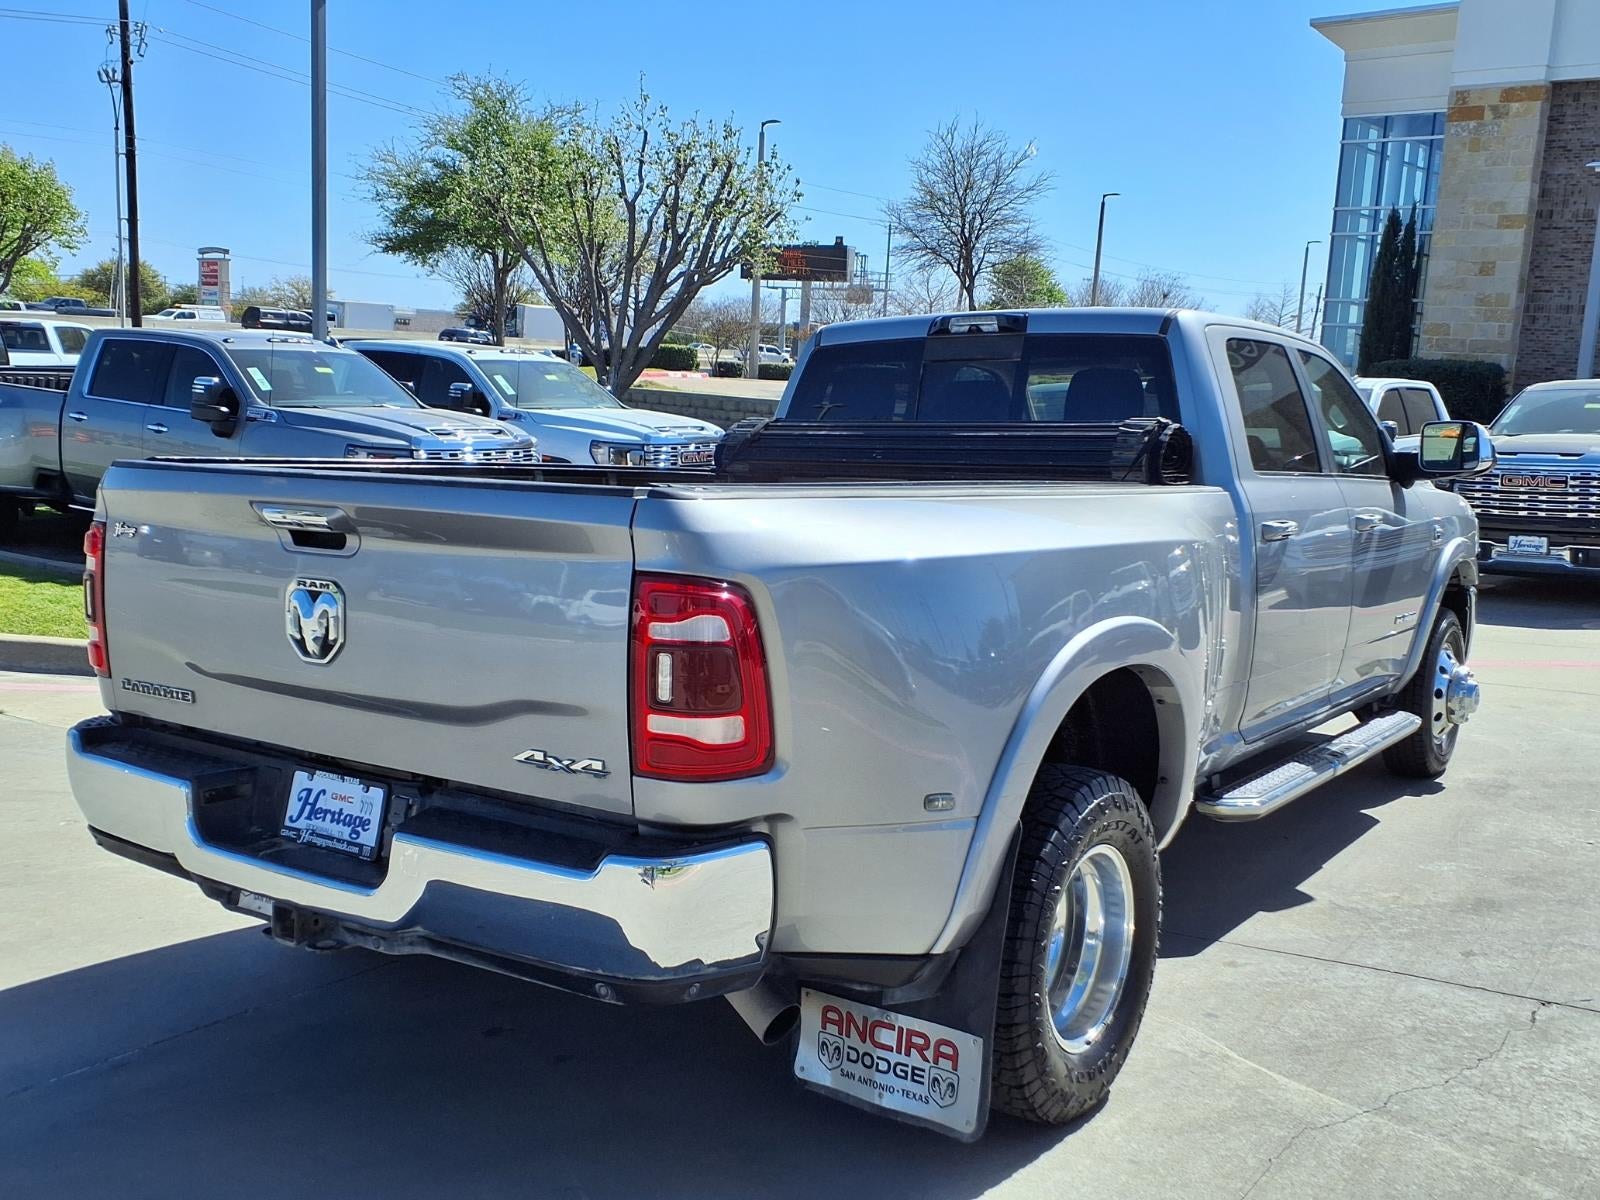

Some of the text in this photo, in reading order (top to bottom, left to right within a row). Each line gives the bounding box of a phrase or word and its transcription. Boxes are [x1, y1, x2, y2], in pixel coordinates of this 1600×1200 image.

[1503, 475, 1566, 487] GMC
[297, 580, 330, 590] RAM
[121, 679, 194, 703] LARAMIE
[331, 792, 354, 805] GMC
[288, 787, 371, 841] Heritage
[280, 828, 298, 839] GMC
[821, 1005, 959, 1071] ANCIRA
[846, 1045, 926, 1085] DODGE
[839, 1067, 856, 1081] SAN
[901, 1090, 930, 1105] TEXAS
